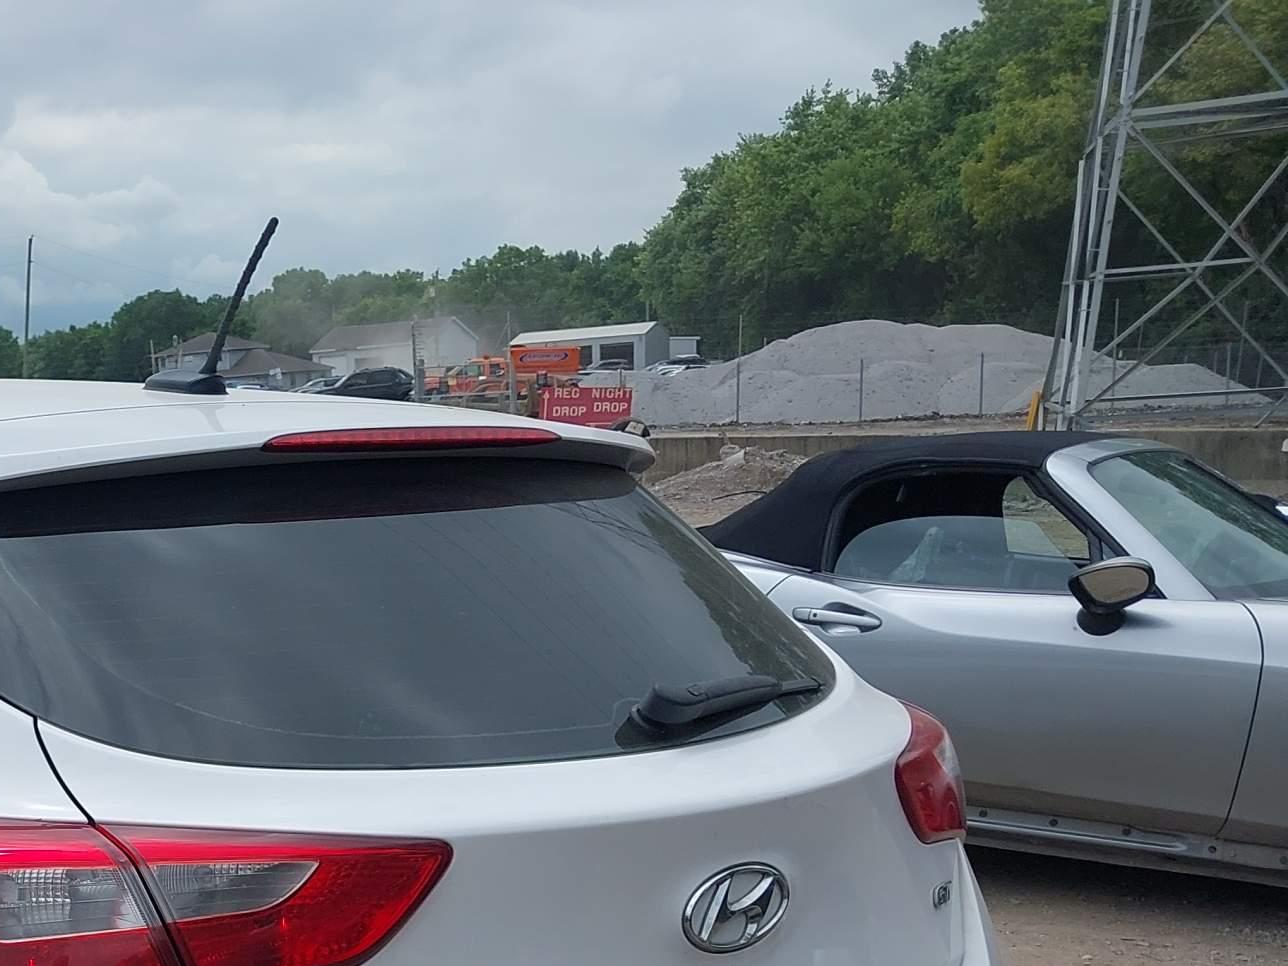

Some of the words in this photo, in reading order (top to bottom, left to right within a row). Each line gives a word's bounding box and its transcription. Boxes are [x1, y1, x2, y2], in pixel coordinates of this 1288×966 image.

[591, 388, 632, 399] NIGHT
[552, 406, 586, 417] DROP
[593, 402, 628, 413] DROP
